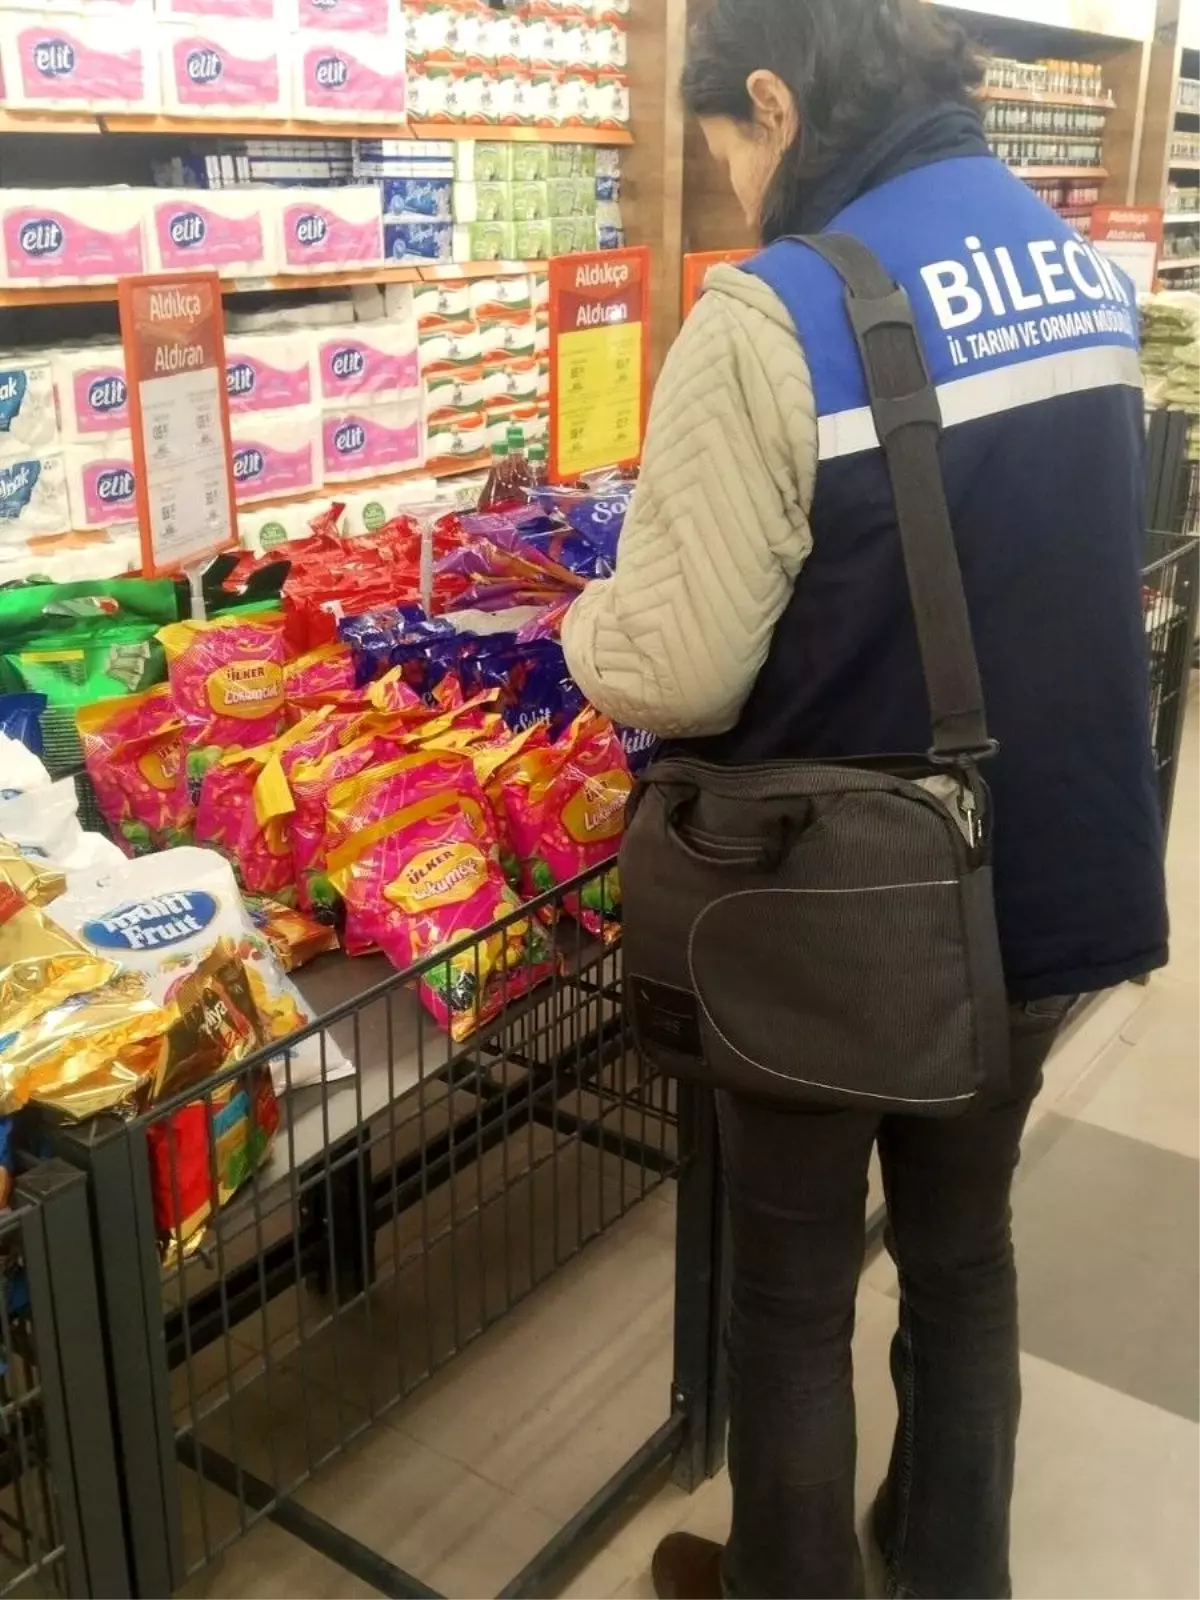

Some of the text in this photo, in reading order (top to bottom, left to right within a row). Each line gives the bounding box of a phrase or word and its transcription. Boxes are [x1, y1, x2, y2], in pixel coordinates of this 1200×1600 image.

[35, 43, 72, 69] elit
[189, 53, 220, 79] elit
[316, 61, 347, 85] elit
[21, 224, 63, 252] elit
[171, 213, 203, 241] elit
[297, 216, 327, 243] elit
[575, 263, 629, 288] Aldıkça
[149, 292, 202, 323] Aldıkça
[947, 335, 969, 366] İL
[967, 325, 1020, 360] TARIM
[1018, 320, 1041, 348] VE
[1041, 310, 1097, 342] ORMAN
[155, 344, 204, 371] Aldıran
[331, 350, 364, 376] elit
[226, 366, 254, 391] elit
[90, 379, 126, 407] elit
[334, 425, 365, 452] elit
[233, 452, 262, 477] elit
[98, 470, 134, 497] elit
[226, 667, 265, 681] ÜLKER
[406, 851, 455, 885] ÜLKER
[121, 914, 203, 949] Fruit
